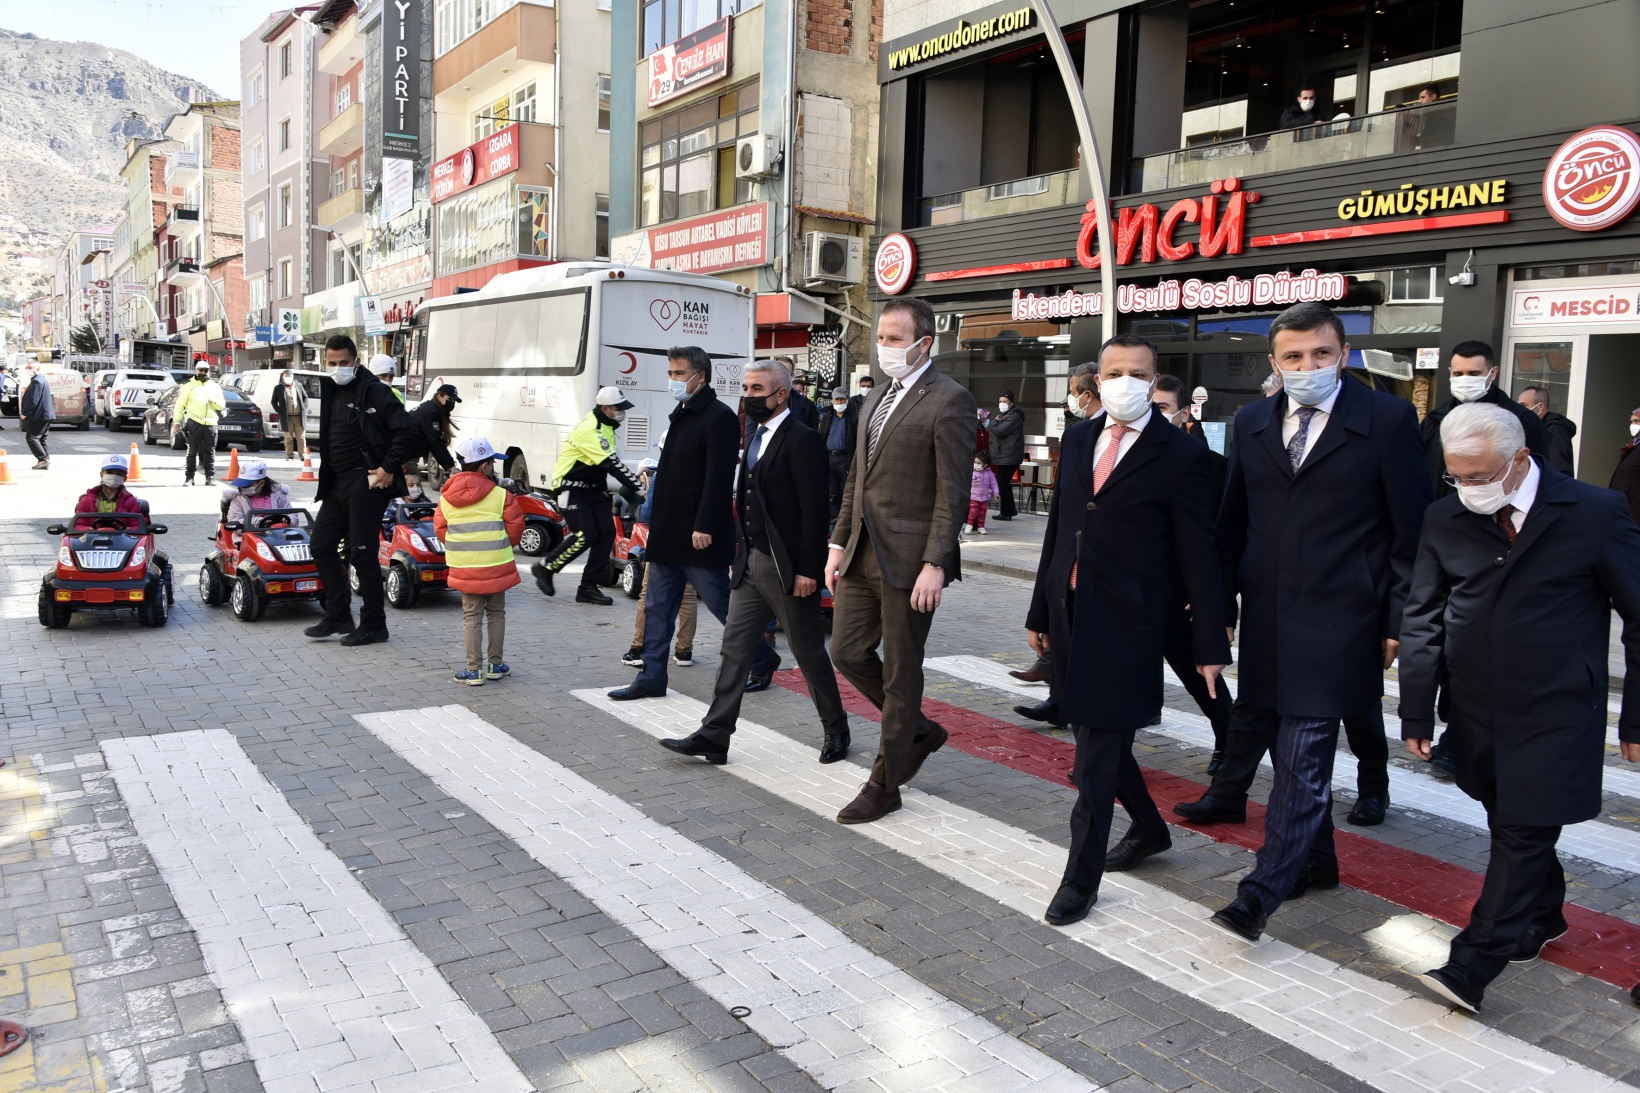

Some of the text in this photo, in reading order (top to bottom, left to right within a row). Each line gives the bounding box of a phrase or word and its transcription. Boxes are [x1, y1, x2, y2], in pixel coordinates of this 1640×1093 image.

[888, 6, 1030, 70] www.oncudoner.com
[394, 46, 410, 130] PARTİ
[661, 80, 671, 94] 29
[389, 140, 411, 148] MERKEZ
[489, 131, 512, 154] IZGARA
[434, 159, 454, 180] MERKEZ
[490, 154, 512, 177] ÇORBA
[435, 178, 454, 198] DÜRÜM
[1337, 180, 1506, 220] GÜMÜŞHANE
[669, 227, 690, 249] TARSUN
[691, 224, 715, 245] ARTABEL
[715, 214, 736, 240] VADİSİ
[736, 208, 762, 234] KÖYLERİ
[692, 252, 700, 269] VE
[700, 246, 733, 268] DAYANIŞMA
[734, 237, 761, 262] DERNEĞİ
[1011, 268, 1345, 320] İskenderu Usulü Soslu Dürüm
[1550, 294, 1631, 317] MESCİD
[683, 301, 709, 314] KAN
[683, 313, 709, 323] BAĞIŞI
[683, 322, 708, 330] HAYAT
